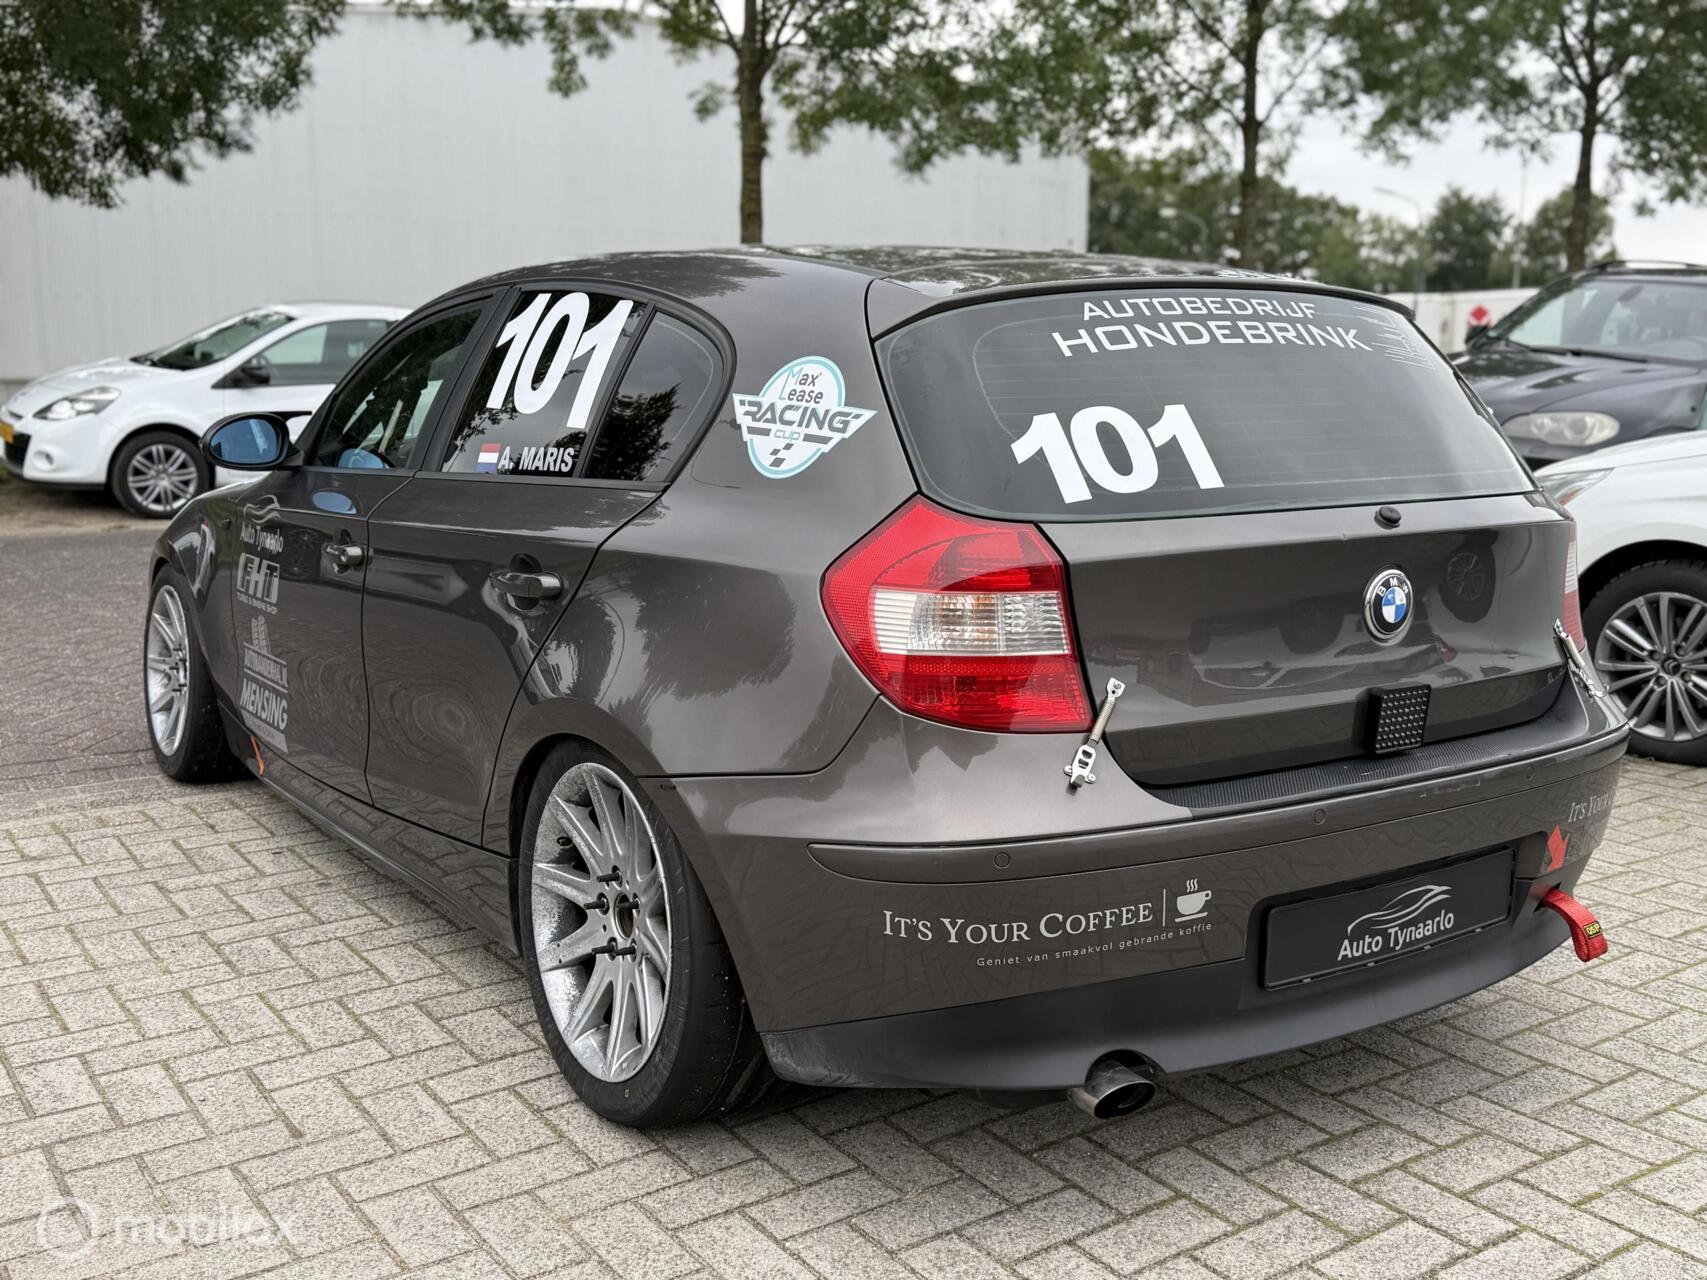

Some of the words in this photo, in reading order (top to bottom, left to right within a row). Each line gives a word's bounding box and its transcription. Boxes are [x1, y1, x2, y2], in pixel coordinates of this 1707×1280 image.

[1083, 297, 1316, 321] AUTOBEDRIJF
[1051, 320, 1373, 357] HONDEBRINK
[486, 292, 634, 429] 101
[789, 367, 820, 387] Max
[739, 399, 862, 434] RACING
[498, 446, 513, 470] A.
[519, 447, 575, 472] MARIS
[1010, 404, 1225, 504] 101
[240, 521, 256, 545] Auto
[1376, 577, 1409, 597] BMW
[240, 678, 288, 731] MENSING
[940, 917, 1031, 945] YOUR
[1039, 902, 1154, 938] COFFEE
[1337, 934, 1383, 961] Auto
[1387, 909, 1455, 951] Tynaarlo
[977, 956, 1020, 967] Geniet
[1027, 953, 1048, 963] van
[1055, 941, 1113, 959] smaakvol
[1119, 930, 1174, 949] gebrande
[1179, 922, 1213, 937] koffie
